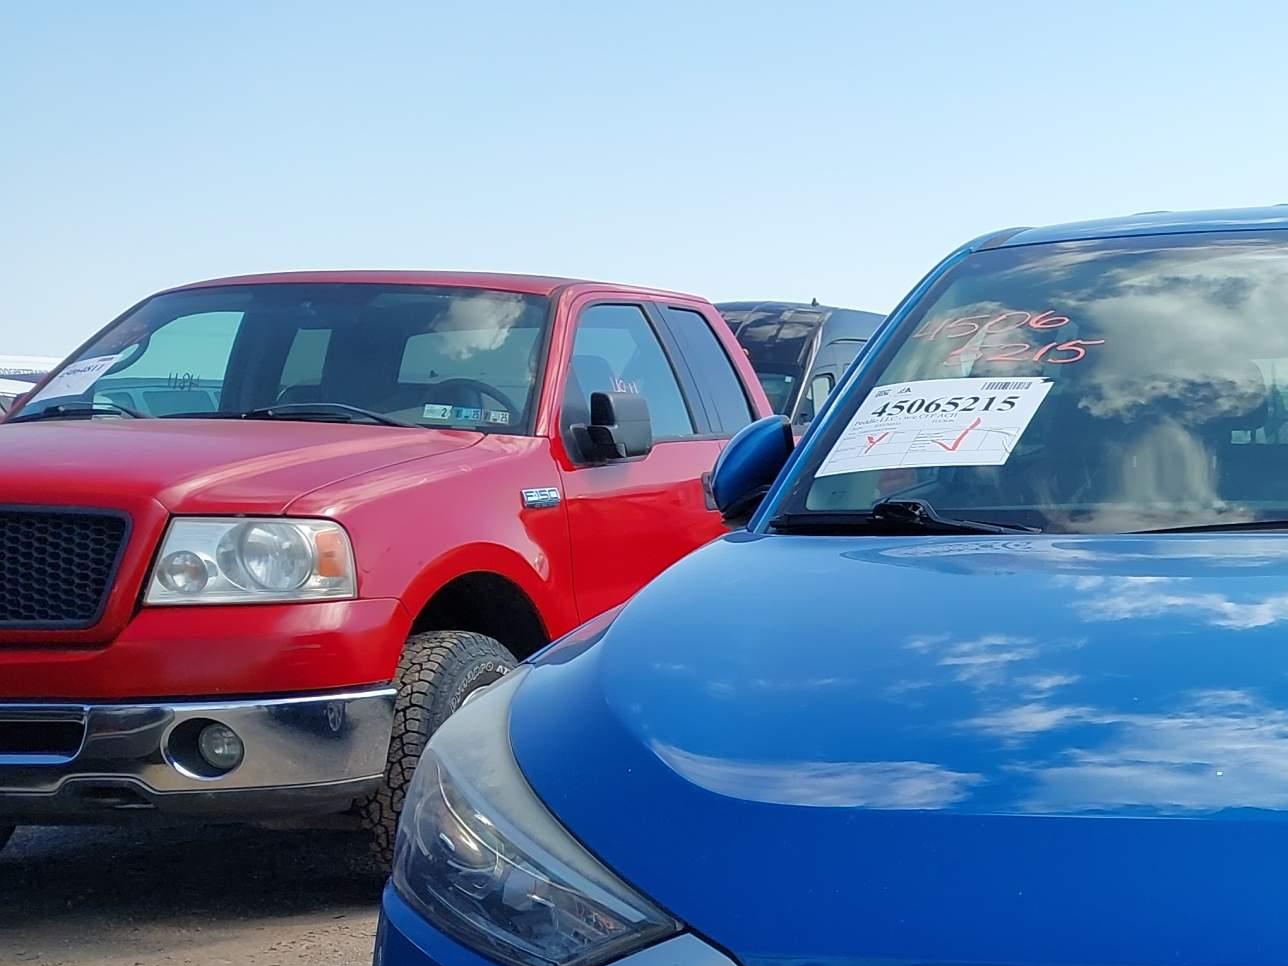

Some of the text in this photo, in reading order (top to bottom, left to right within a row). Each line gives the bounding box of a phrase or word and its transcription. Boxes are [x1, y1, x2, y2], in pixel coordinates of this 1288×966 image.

[912, 310, 1070, 341] 4506
[943, 339, 1105, 368] 5215
[871, 395, 1021, 418] 45065215
